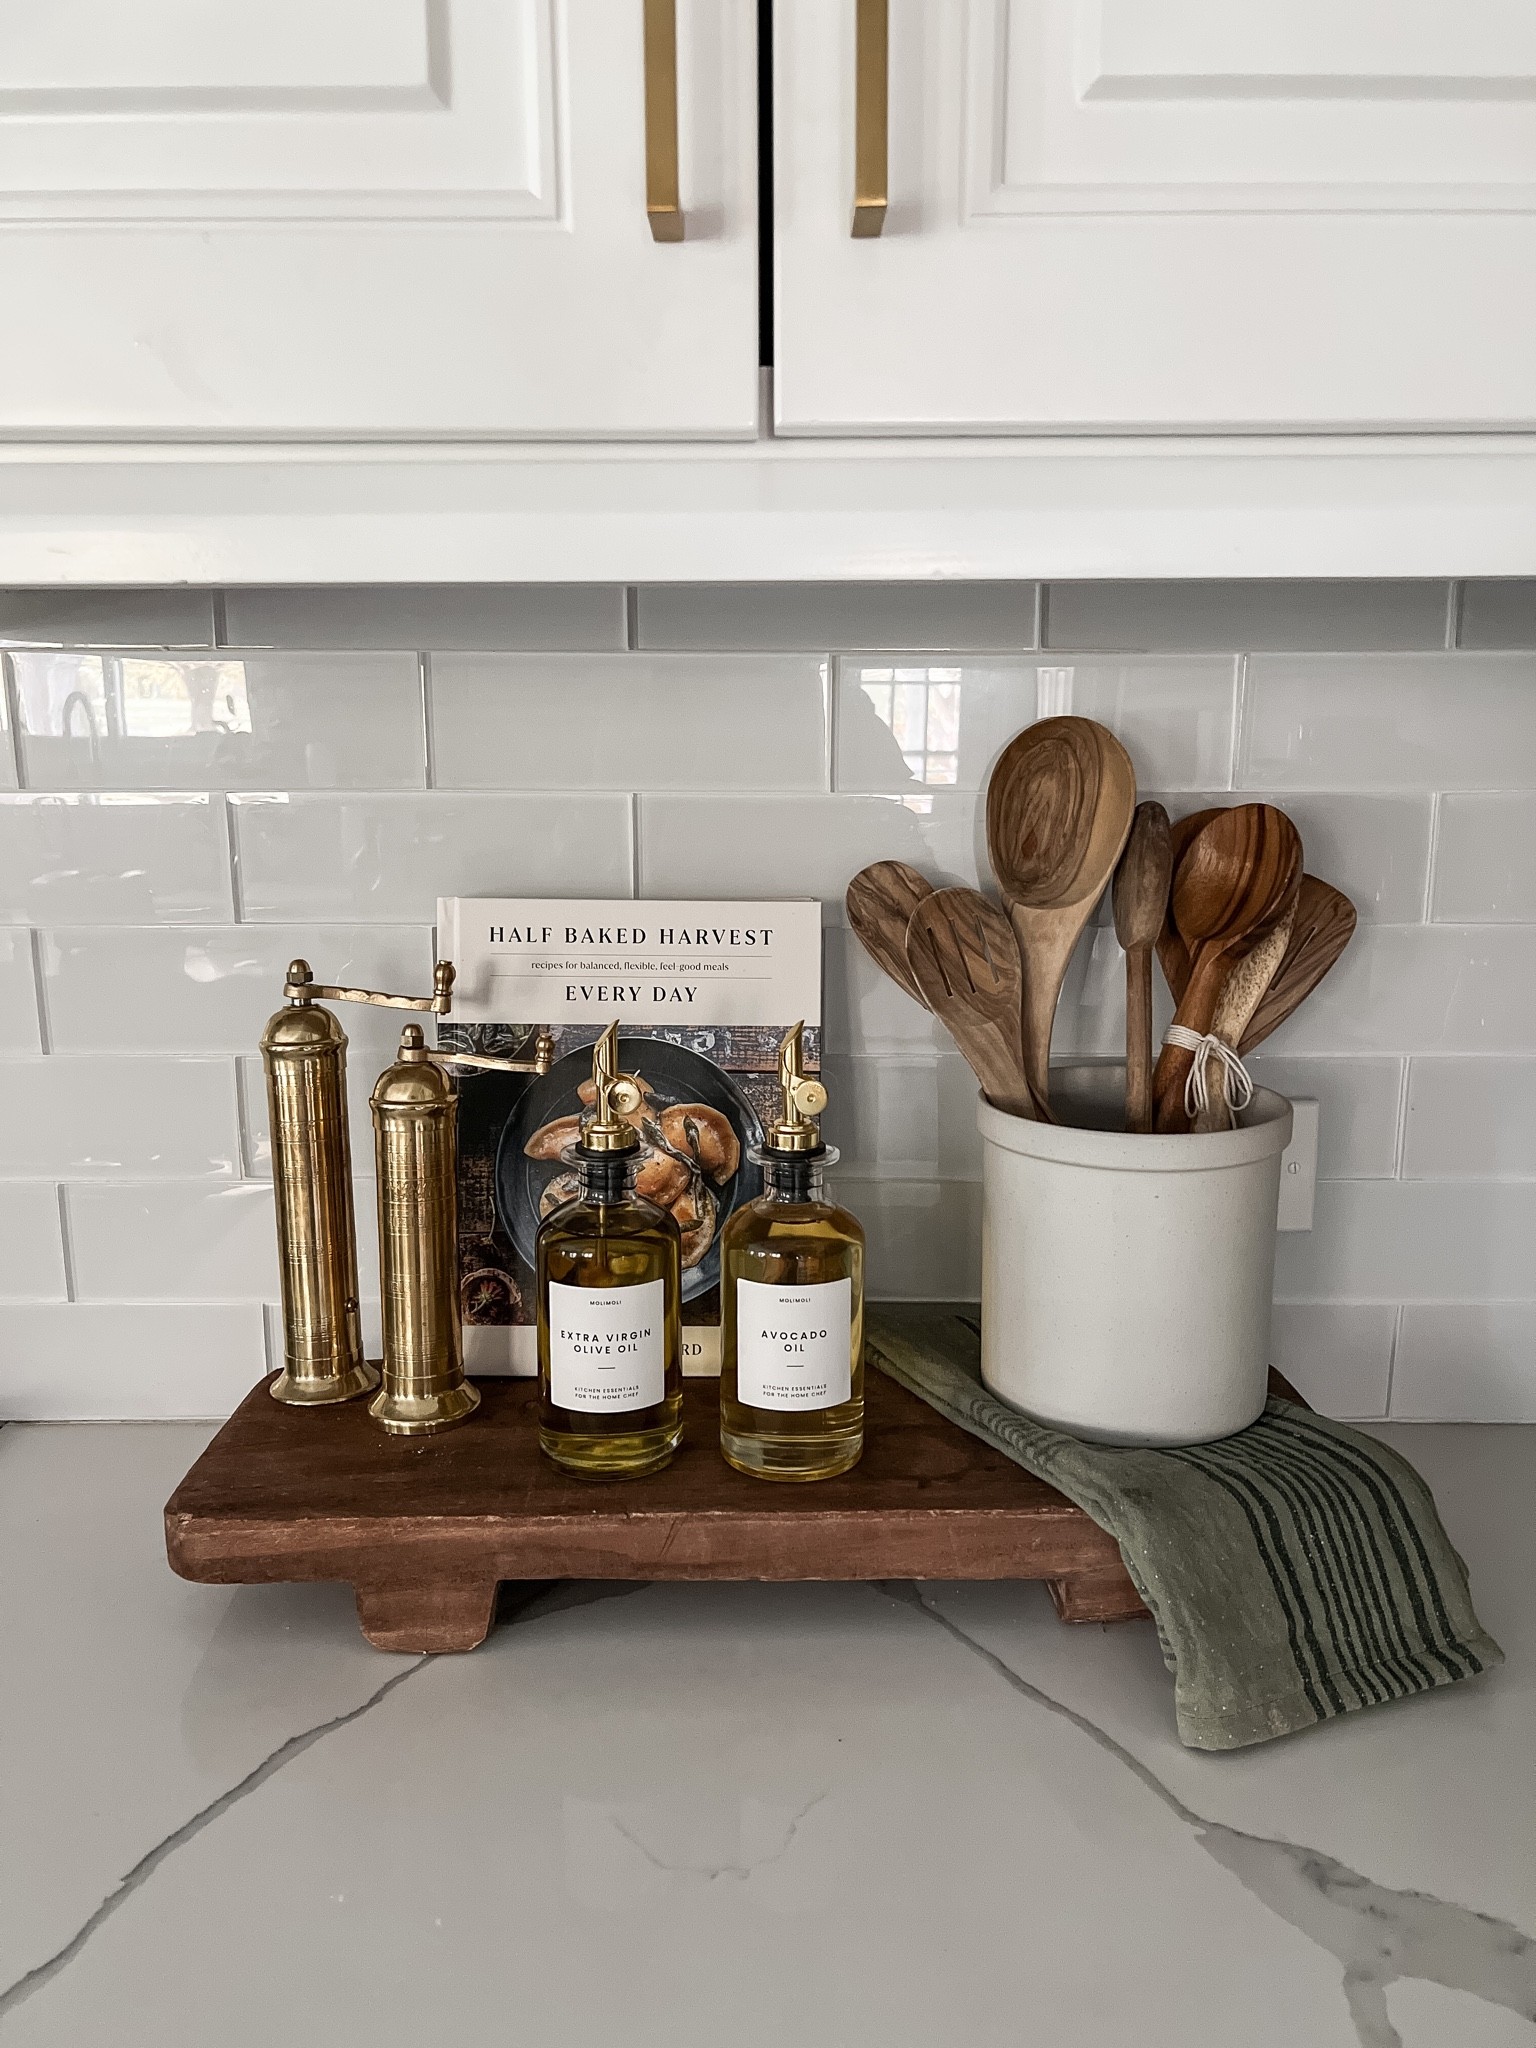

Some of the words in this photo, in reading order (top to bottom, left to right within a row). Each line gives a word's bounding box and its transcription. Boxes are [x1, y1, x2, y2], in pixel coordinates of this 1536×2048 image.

[489, 926, 553, 944] HALF
[564, 927, 647, 945] BAKED
[659, 928, 774, 946] HARVEST
[531, 961, 564, 971] recipes
[565, 961, 578, 970] for
[580, 961, 622, 971] balanced,
[624, 961, 658, 971] flexible,
[660, 961, 702, 972] feel-good
[703, 962, 729, 971] meals
[565, 985, 642, 1002] EVERY
[652, 986, 698, 1003] DAY
[560, 1330, 599, 1343] EXTRA
[606, 1328, 651, 1342] VIRGIN
[761, 1329, 827, 1341] AVOCADO
[573, 1344, 611, 1354] OLIVE
[617, 1343, 638, 1354] OIL
[783, 1343, 805, 1353] OIL
[602, 1385, 639, 1393] ESSENTIALS
[762, 1384, 789, 1392] KITCHEN
[791, 1383, 827, 1392] ESSENTIALS
